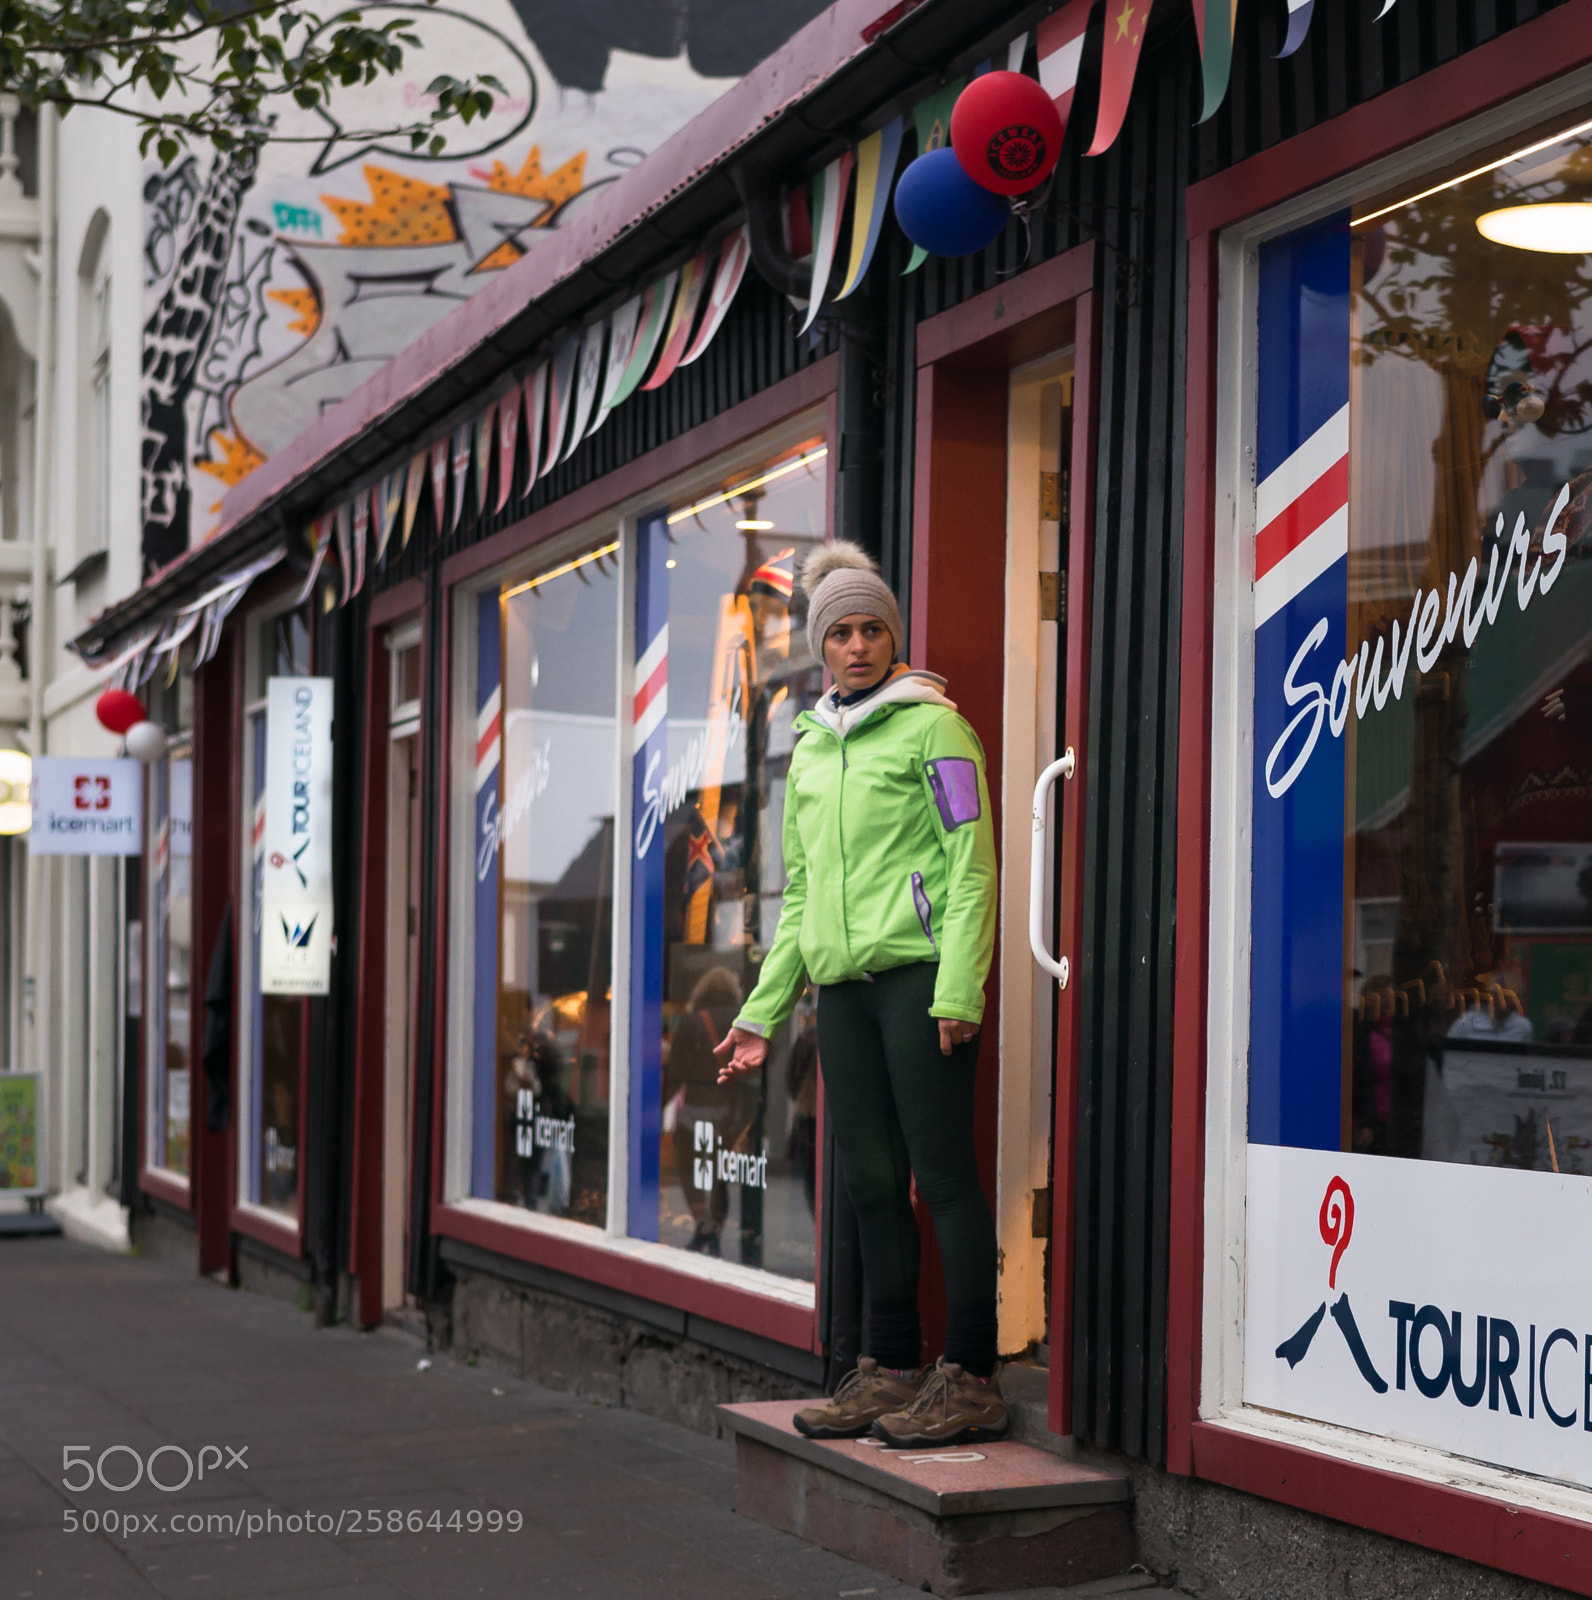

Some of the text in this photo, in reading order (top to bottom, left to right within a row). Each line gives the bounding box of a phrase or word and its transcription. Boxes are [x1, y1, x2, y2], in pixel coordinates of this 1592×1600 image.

[988, 127, 1045, 158] ICEWEAR
[1264, 481, 1571, 799] Souvenirs
[49, 810, 133, 833] icemart
[534, 1102, 575, 1154] icemart
[716, 1135, 767, 1190] icemart
